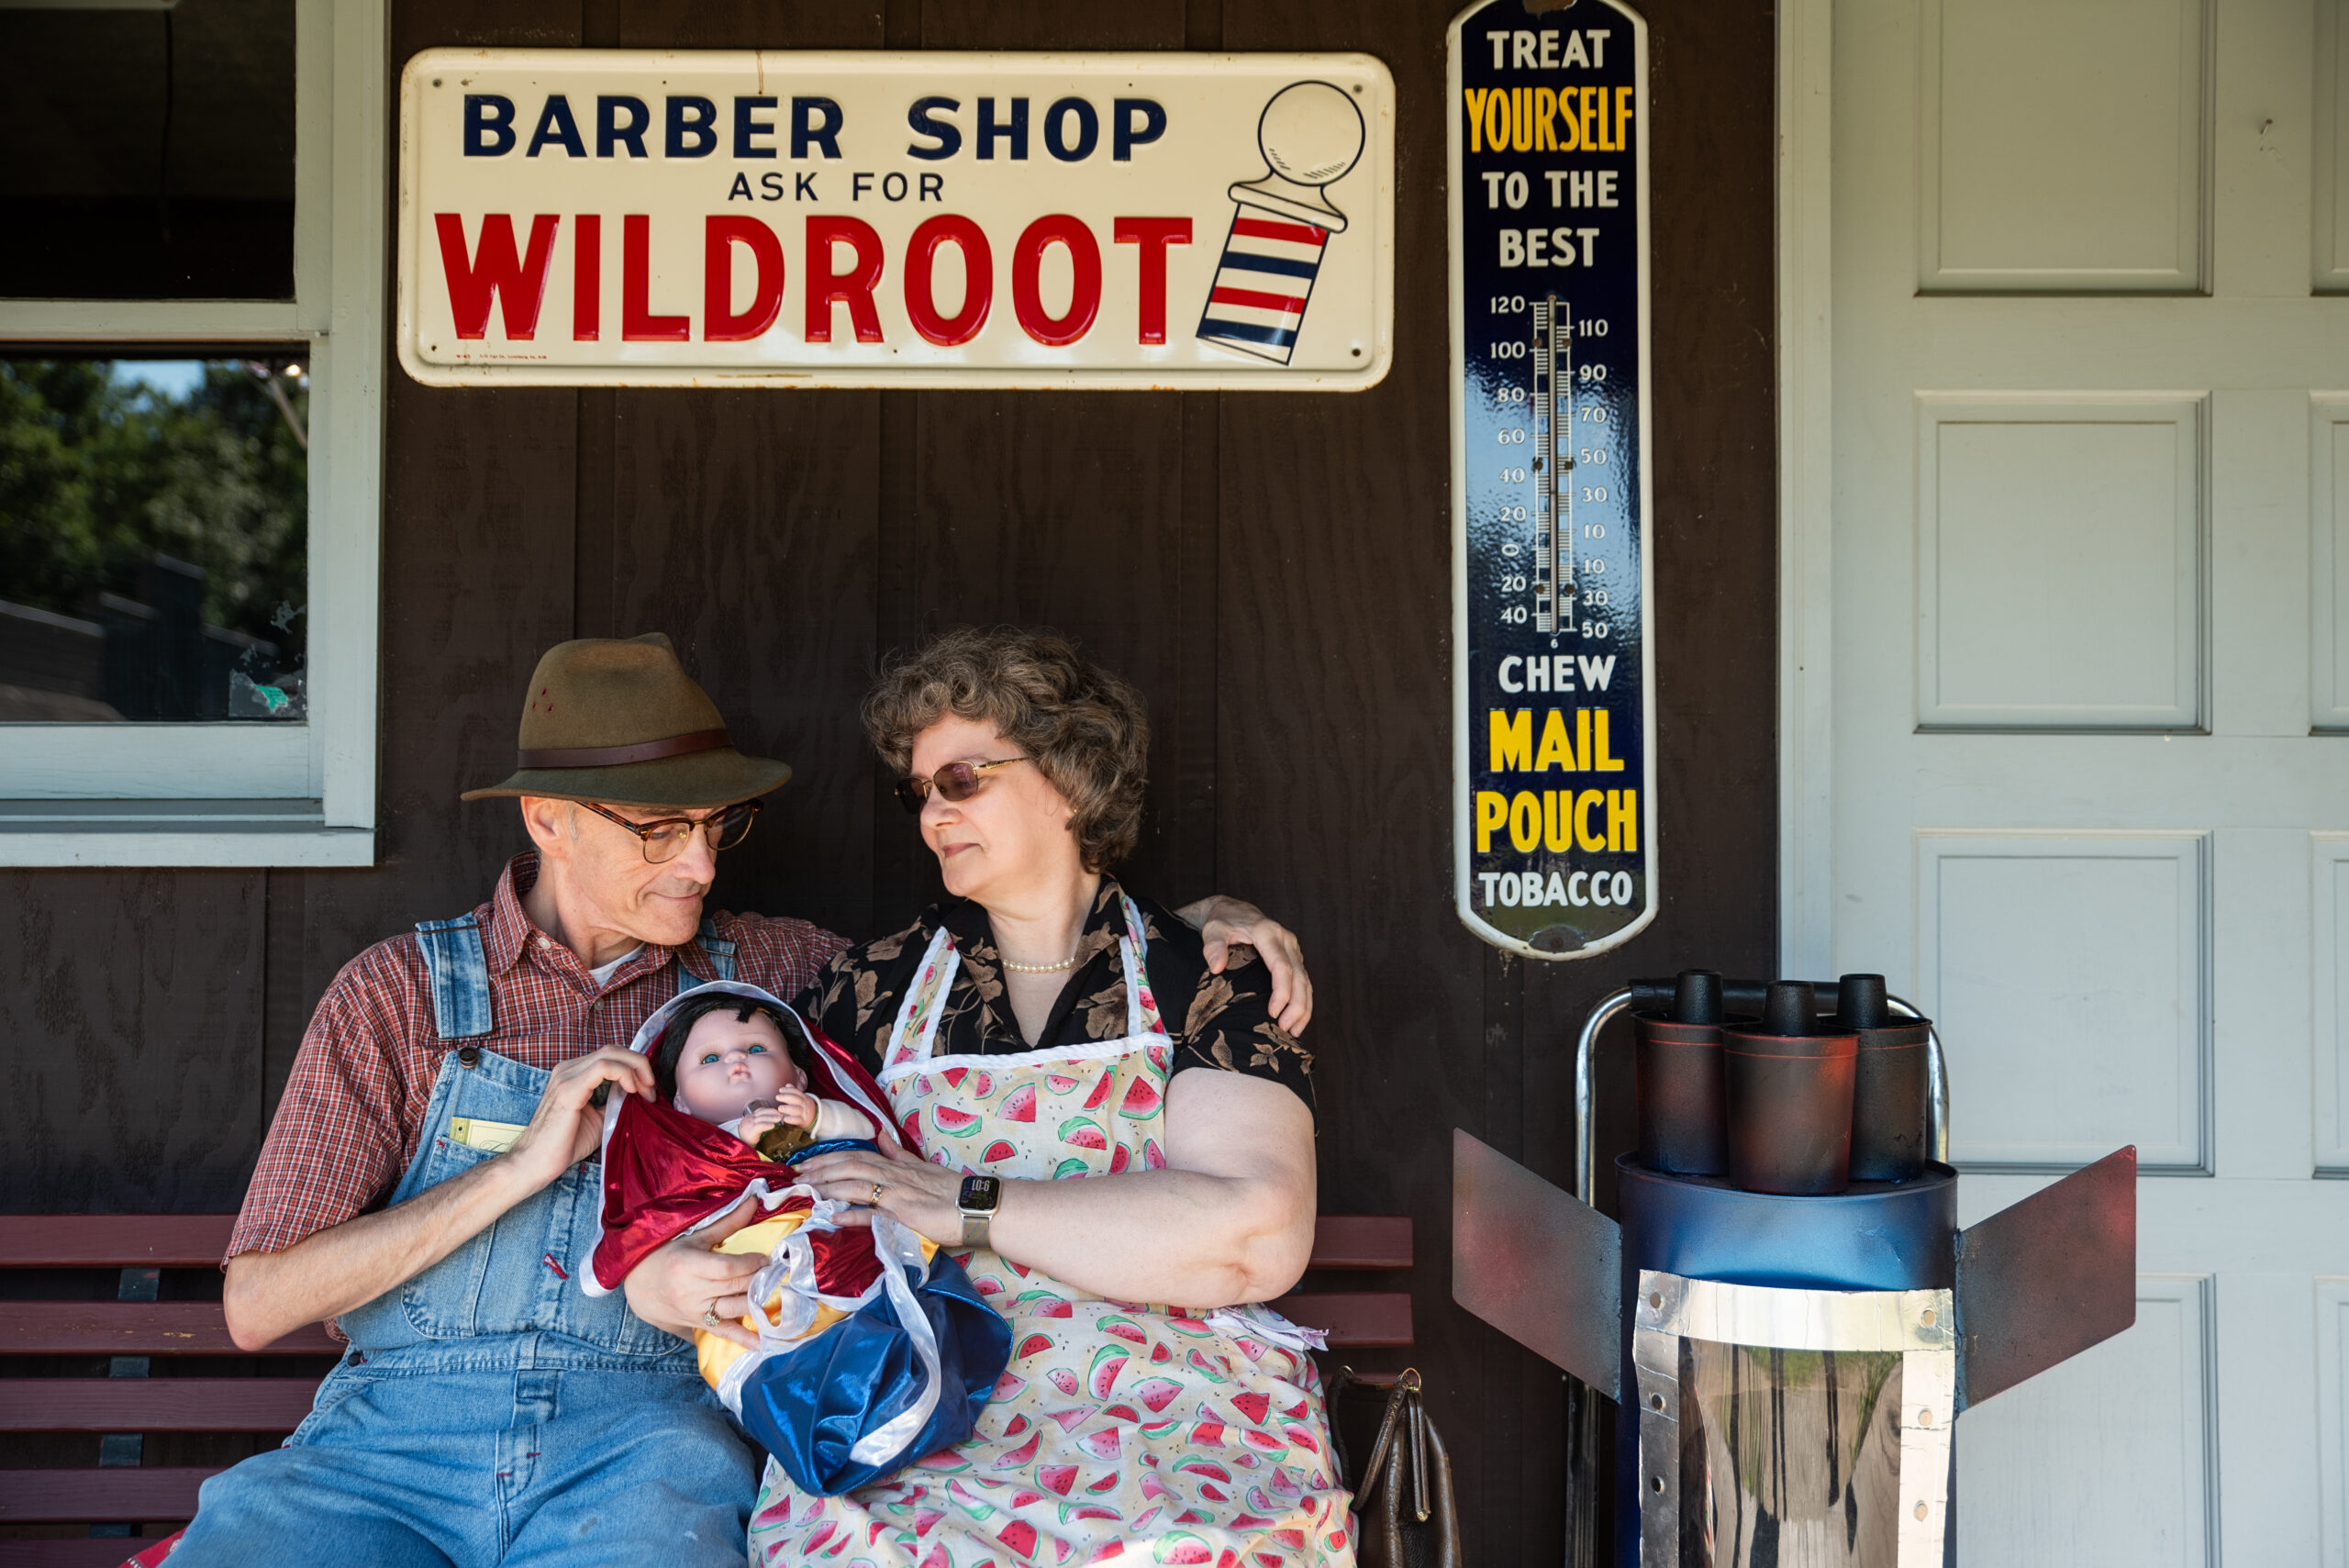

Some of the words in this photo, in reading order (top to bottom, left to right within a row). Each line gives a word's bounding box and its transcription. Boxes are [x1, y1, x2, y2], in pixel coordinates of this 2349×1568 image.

[1486, 29, 1610, 70] TREAT
[463, 94, 843, 160] BARBER
[907, 95, 1167, 161] SHOP
[1464, 85, 1632, 153] YOURSELF
[728, 172, 818, 202] ASK
[852, 172, 944, 202] FOR
[1482, 171, 1529, 209] TO
[1544, 170, 1619, 208] THE
[1499, 227, 1599, 268] BEST
[434, 212, 1193, 347] WILDROOT
[1490, 295, 1525, 314] 120
[1578, 319, 1609, 337] 110
[1490, 341, 1526, 359] 100
[1579, 364, 1607, 381] 90
[1497, 387, 1525, 403] 80
[1580, 407, 1607, 423] 70
[1497, 428, 1525, 445] 60
[1580, 448, 1607, 465] 50
[1499, 467, 1525, 484] 40
[1581, 486, 1608, 503] 30
[1499, 506, 1527, 522] 20
[1584, 524, 1606, 539] 10
[1501, 543, 1520, 557] 0
[1584, 558, 1605, 574] 10
[1501, 576, 1527, 592] 20
[1582, 590, 1608, 606] 30
[1500, 606, 1528, 624] 40
[1582, 621, 1608, 639] 50
[1498, 655, 1616, 693] CHEW
[1489, 707, 1624, 772] MAIL
[1475, 789, 1637, 853] POUCH
[1478, 871, 1632, 907] TOBACCO
